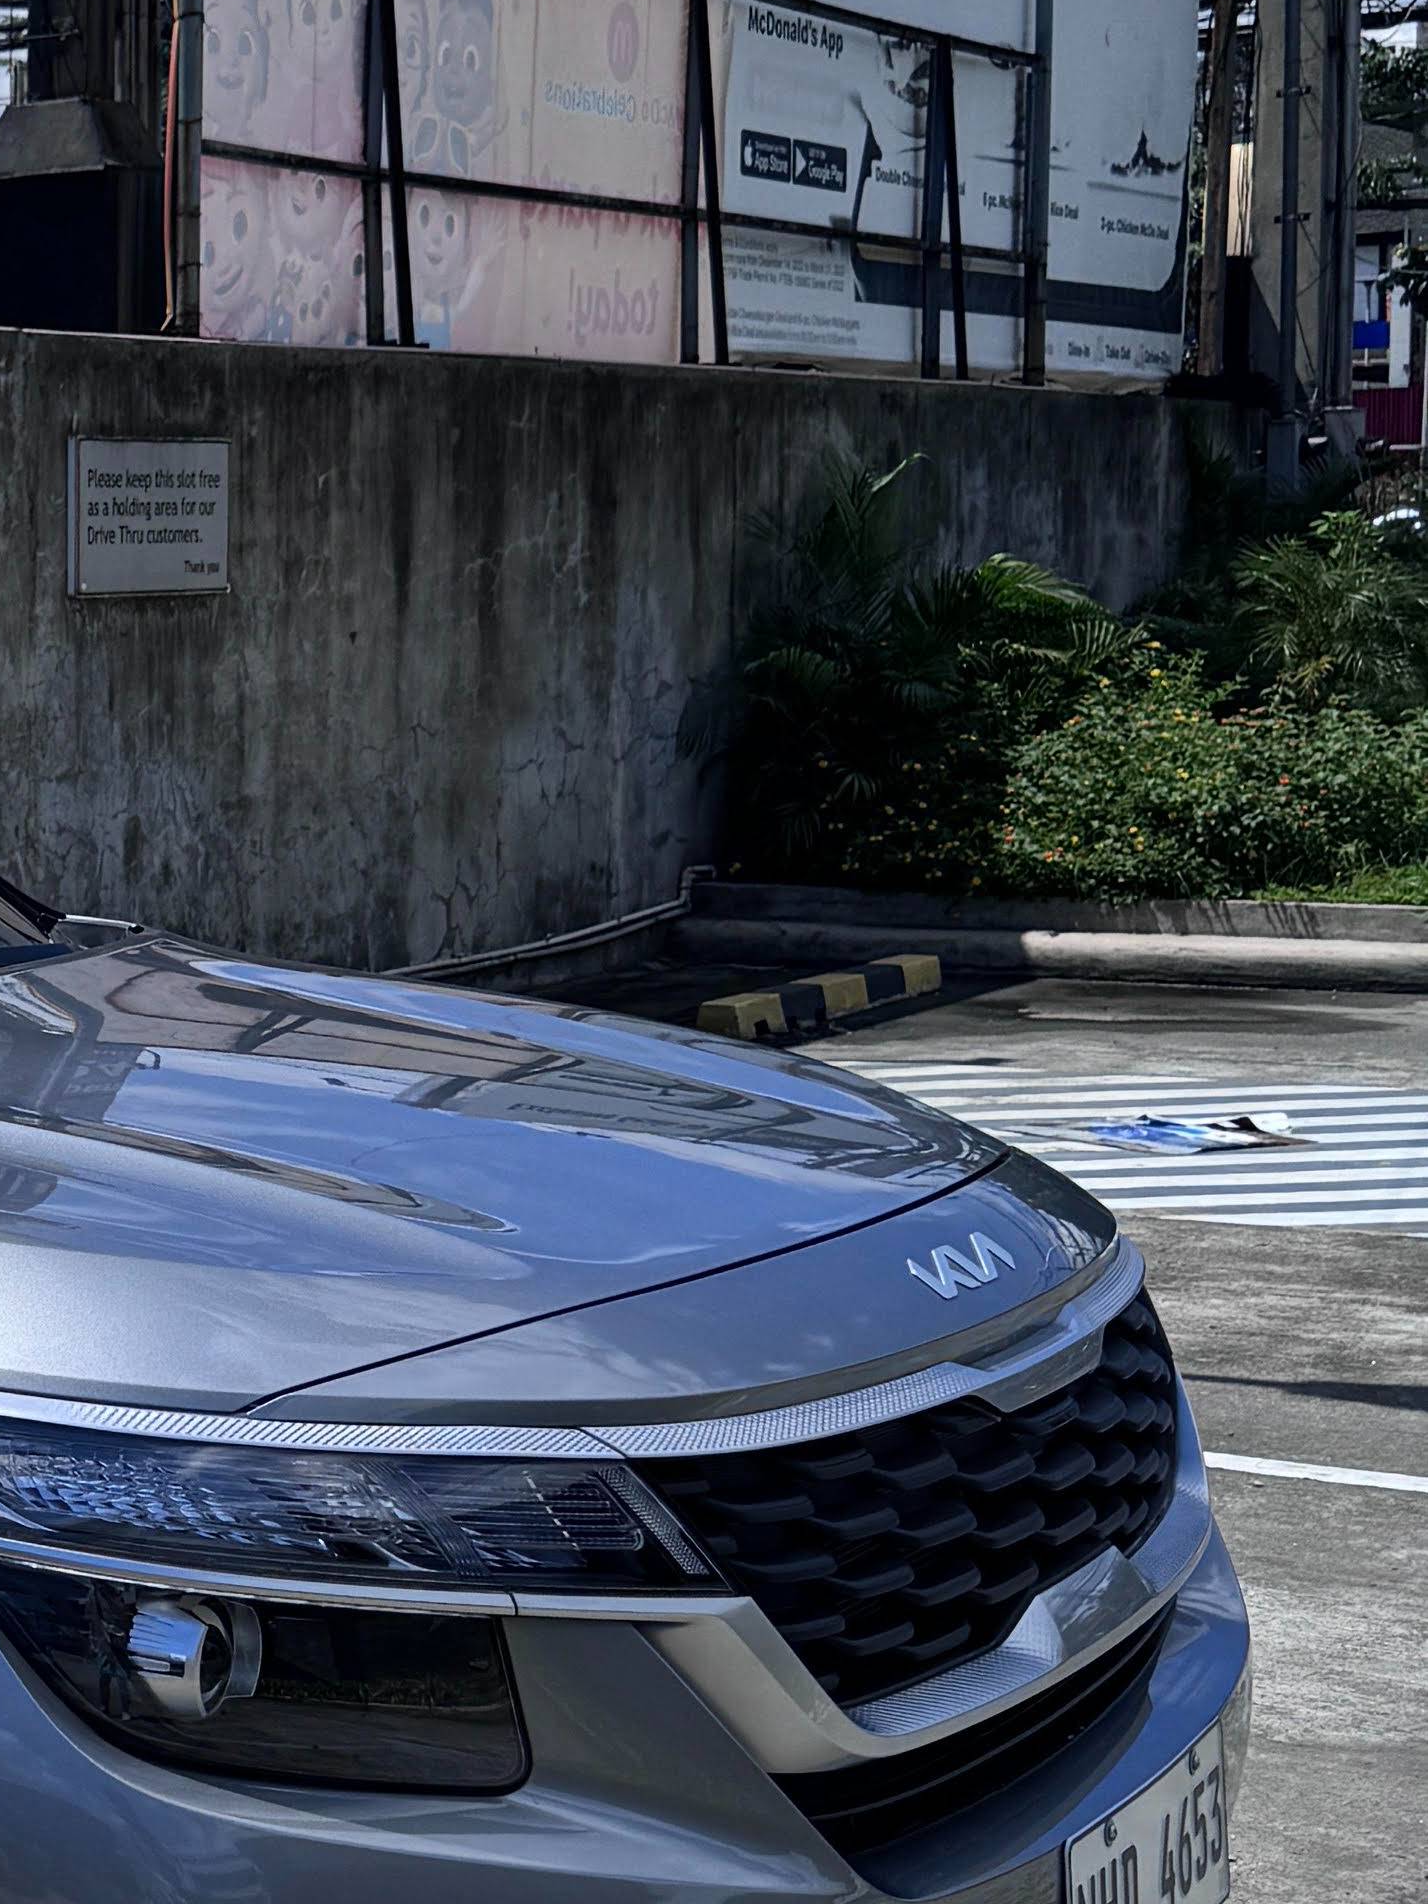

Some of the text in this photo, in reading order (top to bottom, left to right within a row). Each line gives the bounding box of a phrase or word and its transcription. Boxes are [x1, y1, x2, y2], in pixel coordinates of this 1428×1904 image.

[748, 5, 844, 60] McDonald's App
[87, 468, 221, 492] Please keep this slot free
[87, 497, 216, 521] as a holding area for our
[87, 525, 203, 545] Drive Thru customers.
[184, 560, 205, 574] Thank
